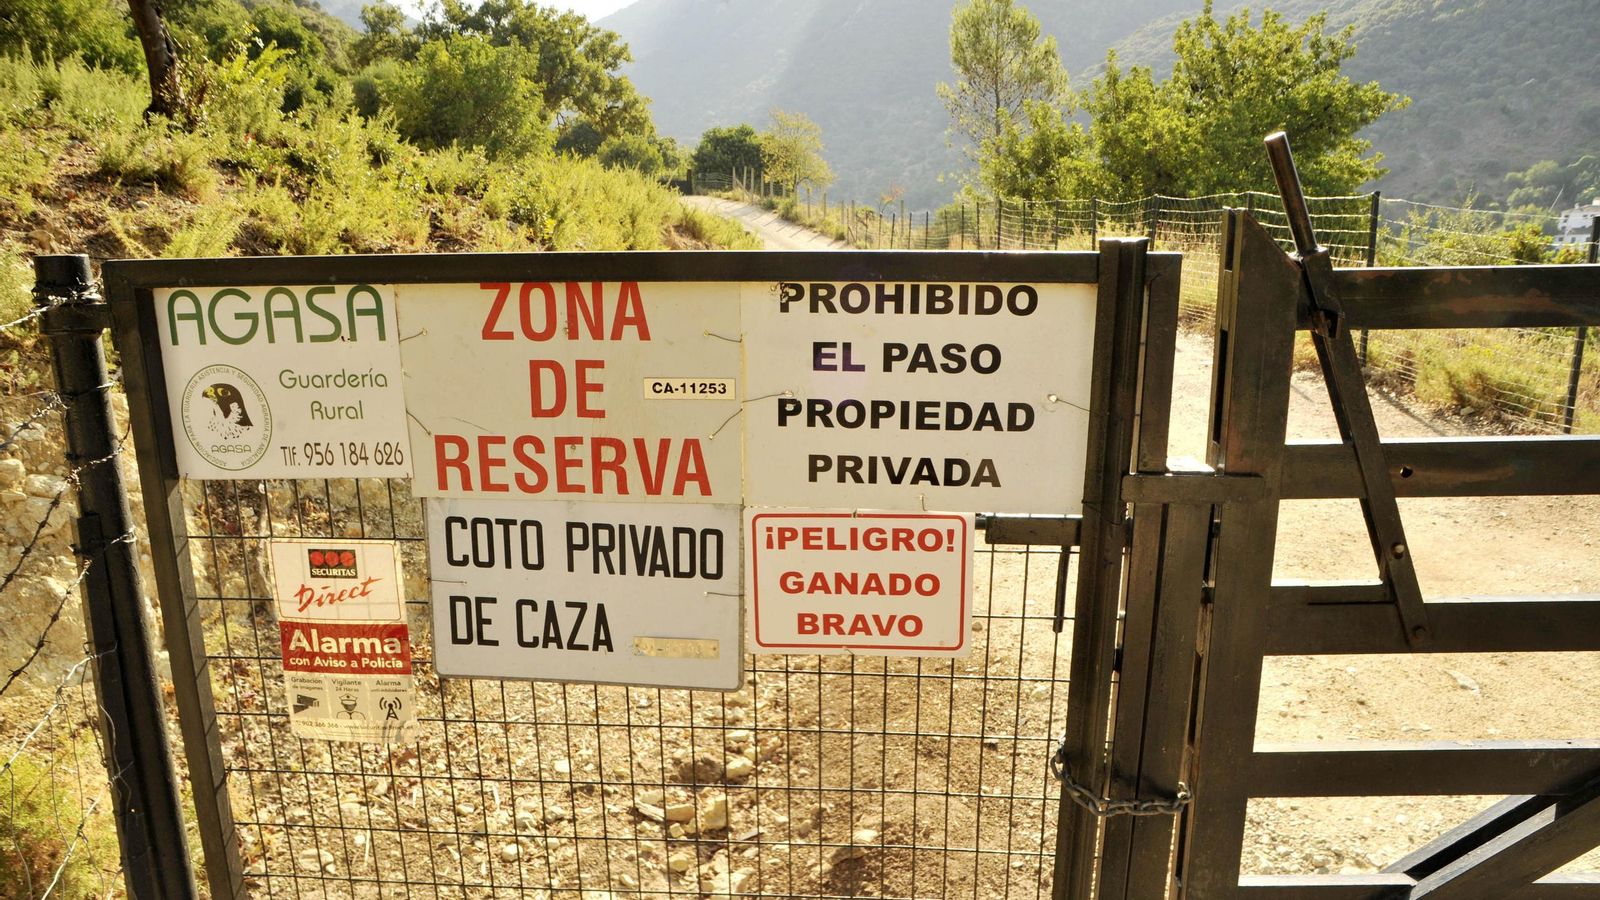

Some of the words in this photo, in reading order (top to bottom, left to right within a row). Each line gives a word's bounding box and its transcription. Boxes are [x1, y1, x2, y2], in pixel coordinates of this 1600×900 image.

[479, 281, 651, 342] ZONA
[779, 282, 1038, 316] PROHIBIDO
[167, 285, 386, 346] AGASA
[812, 341, 866, 372] EL
[882, 342, 1002, 374] PASO
[279, 368, 388, 389] Guardería
[529, 359, 606, 419] DE
[652, 381, 727, 396] CA-11253
[311, 400, 364, 420] Rural
[777, 398, 1035, 432] PROPIEDAD
[211, 444, 252, 453] AGASA
[304, 442, 334, 467] 956
[339, 442, 369, 466] 184
[374, 442, 404, 466] 626
[434, 434, 713, 496] RESERVA
[808, 454, 1002, 488] PRIVADA
[445, 516, 545, 571] COTO
[565, 521, 724, 580] PRIVADO
[765, 526, 955, 552] ¡PELIGRO!
[311, 568, 356, 577] SECURITAS
[779, 571, 941, 597] GANADO
[294, 576, 384, 613] Direct
[449, 595, 500, 647] DE
[515, 598, 614, 653] CAZA
[797, 612, 923, 637] BRAVO
[288, 628, 402, 654] Alarma
[289, 657, 310, 666] con
[313, 656, 347, 668] Aviso
[350, 660, 358, 668] a
[361, 656, 404, 668] Policía
[331, 679, 362, 687] Vigilante
